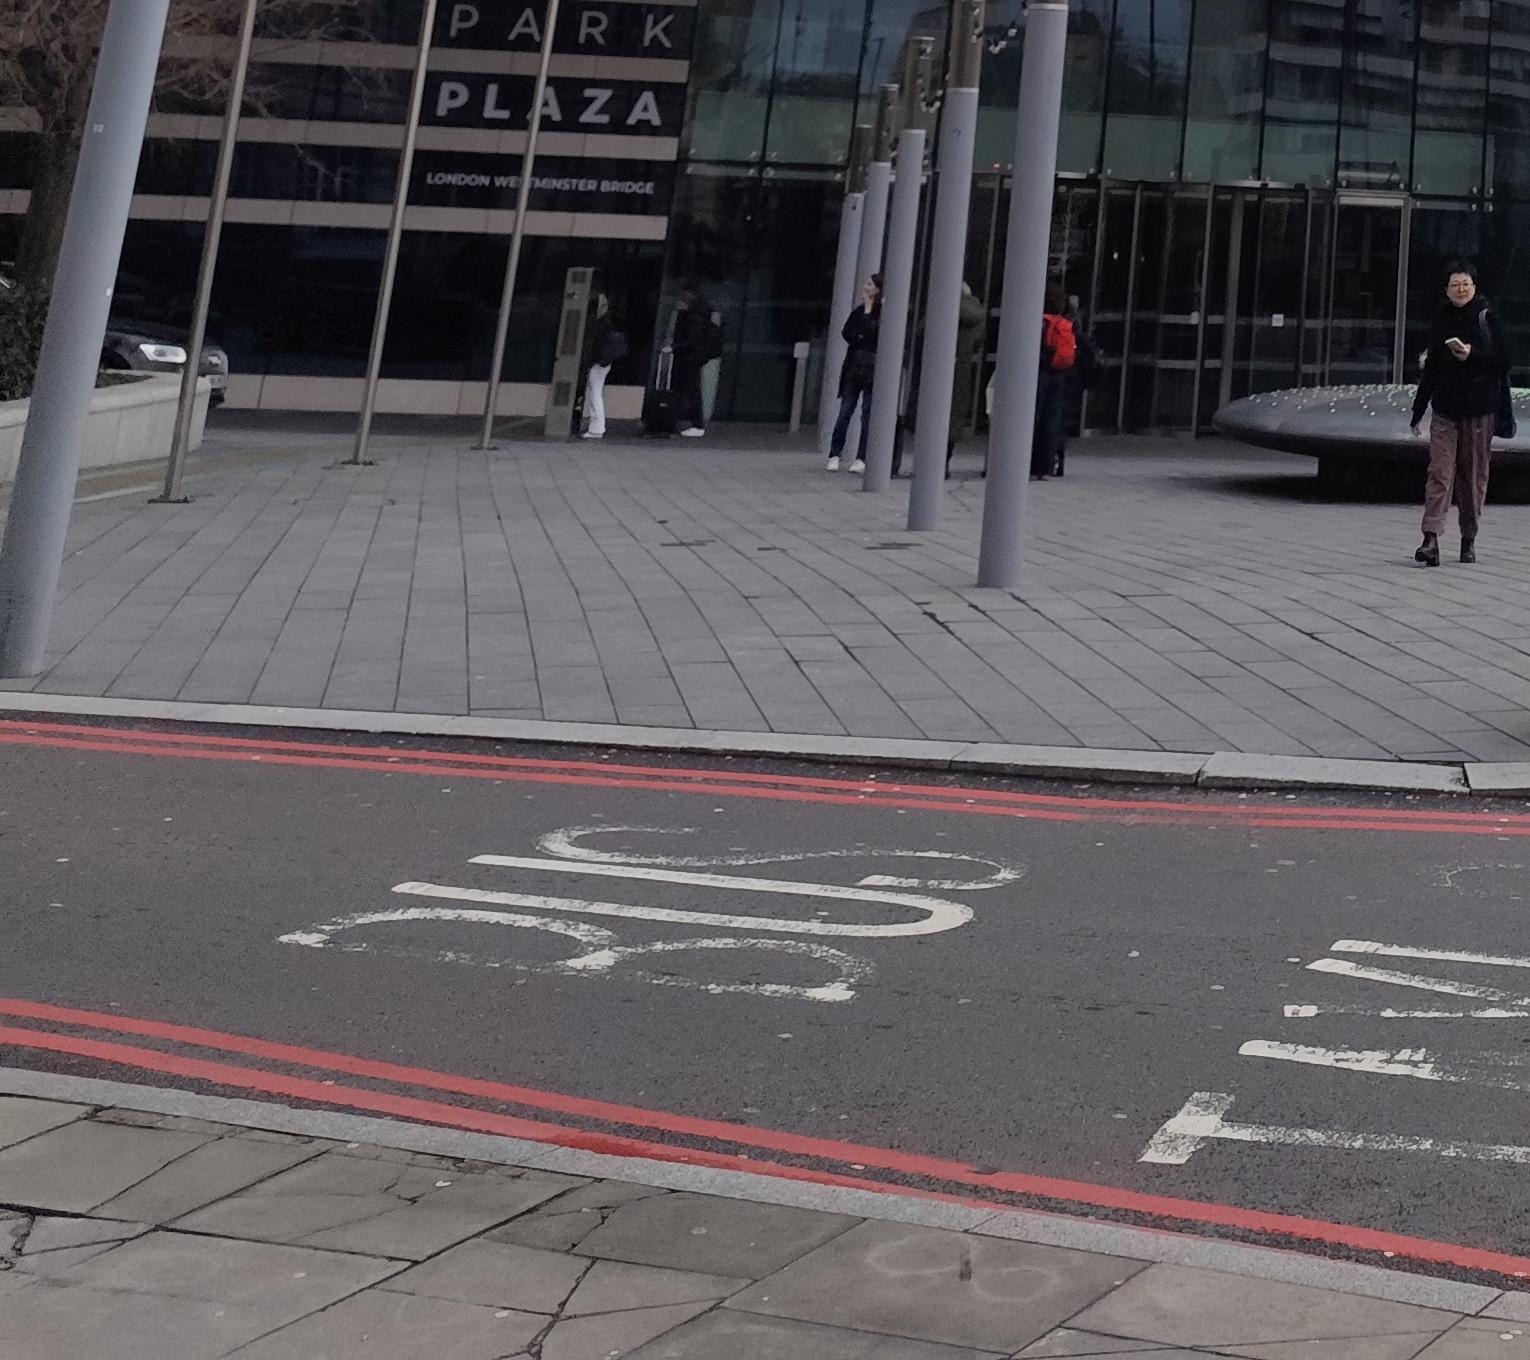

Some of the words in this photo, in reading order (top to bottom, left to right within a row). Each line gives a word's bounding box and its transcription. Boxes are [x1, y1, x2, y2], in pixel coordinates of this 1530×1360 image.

[449, 3, 676, 49] PARK
[436, 82, 662, 127] PLAZA
[426, 172, 490, 187] LONDON
[600, 180, 655, 195] BRIDGE
[277, 825, 1022, 1003] BUS
